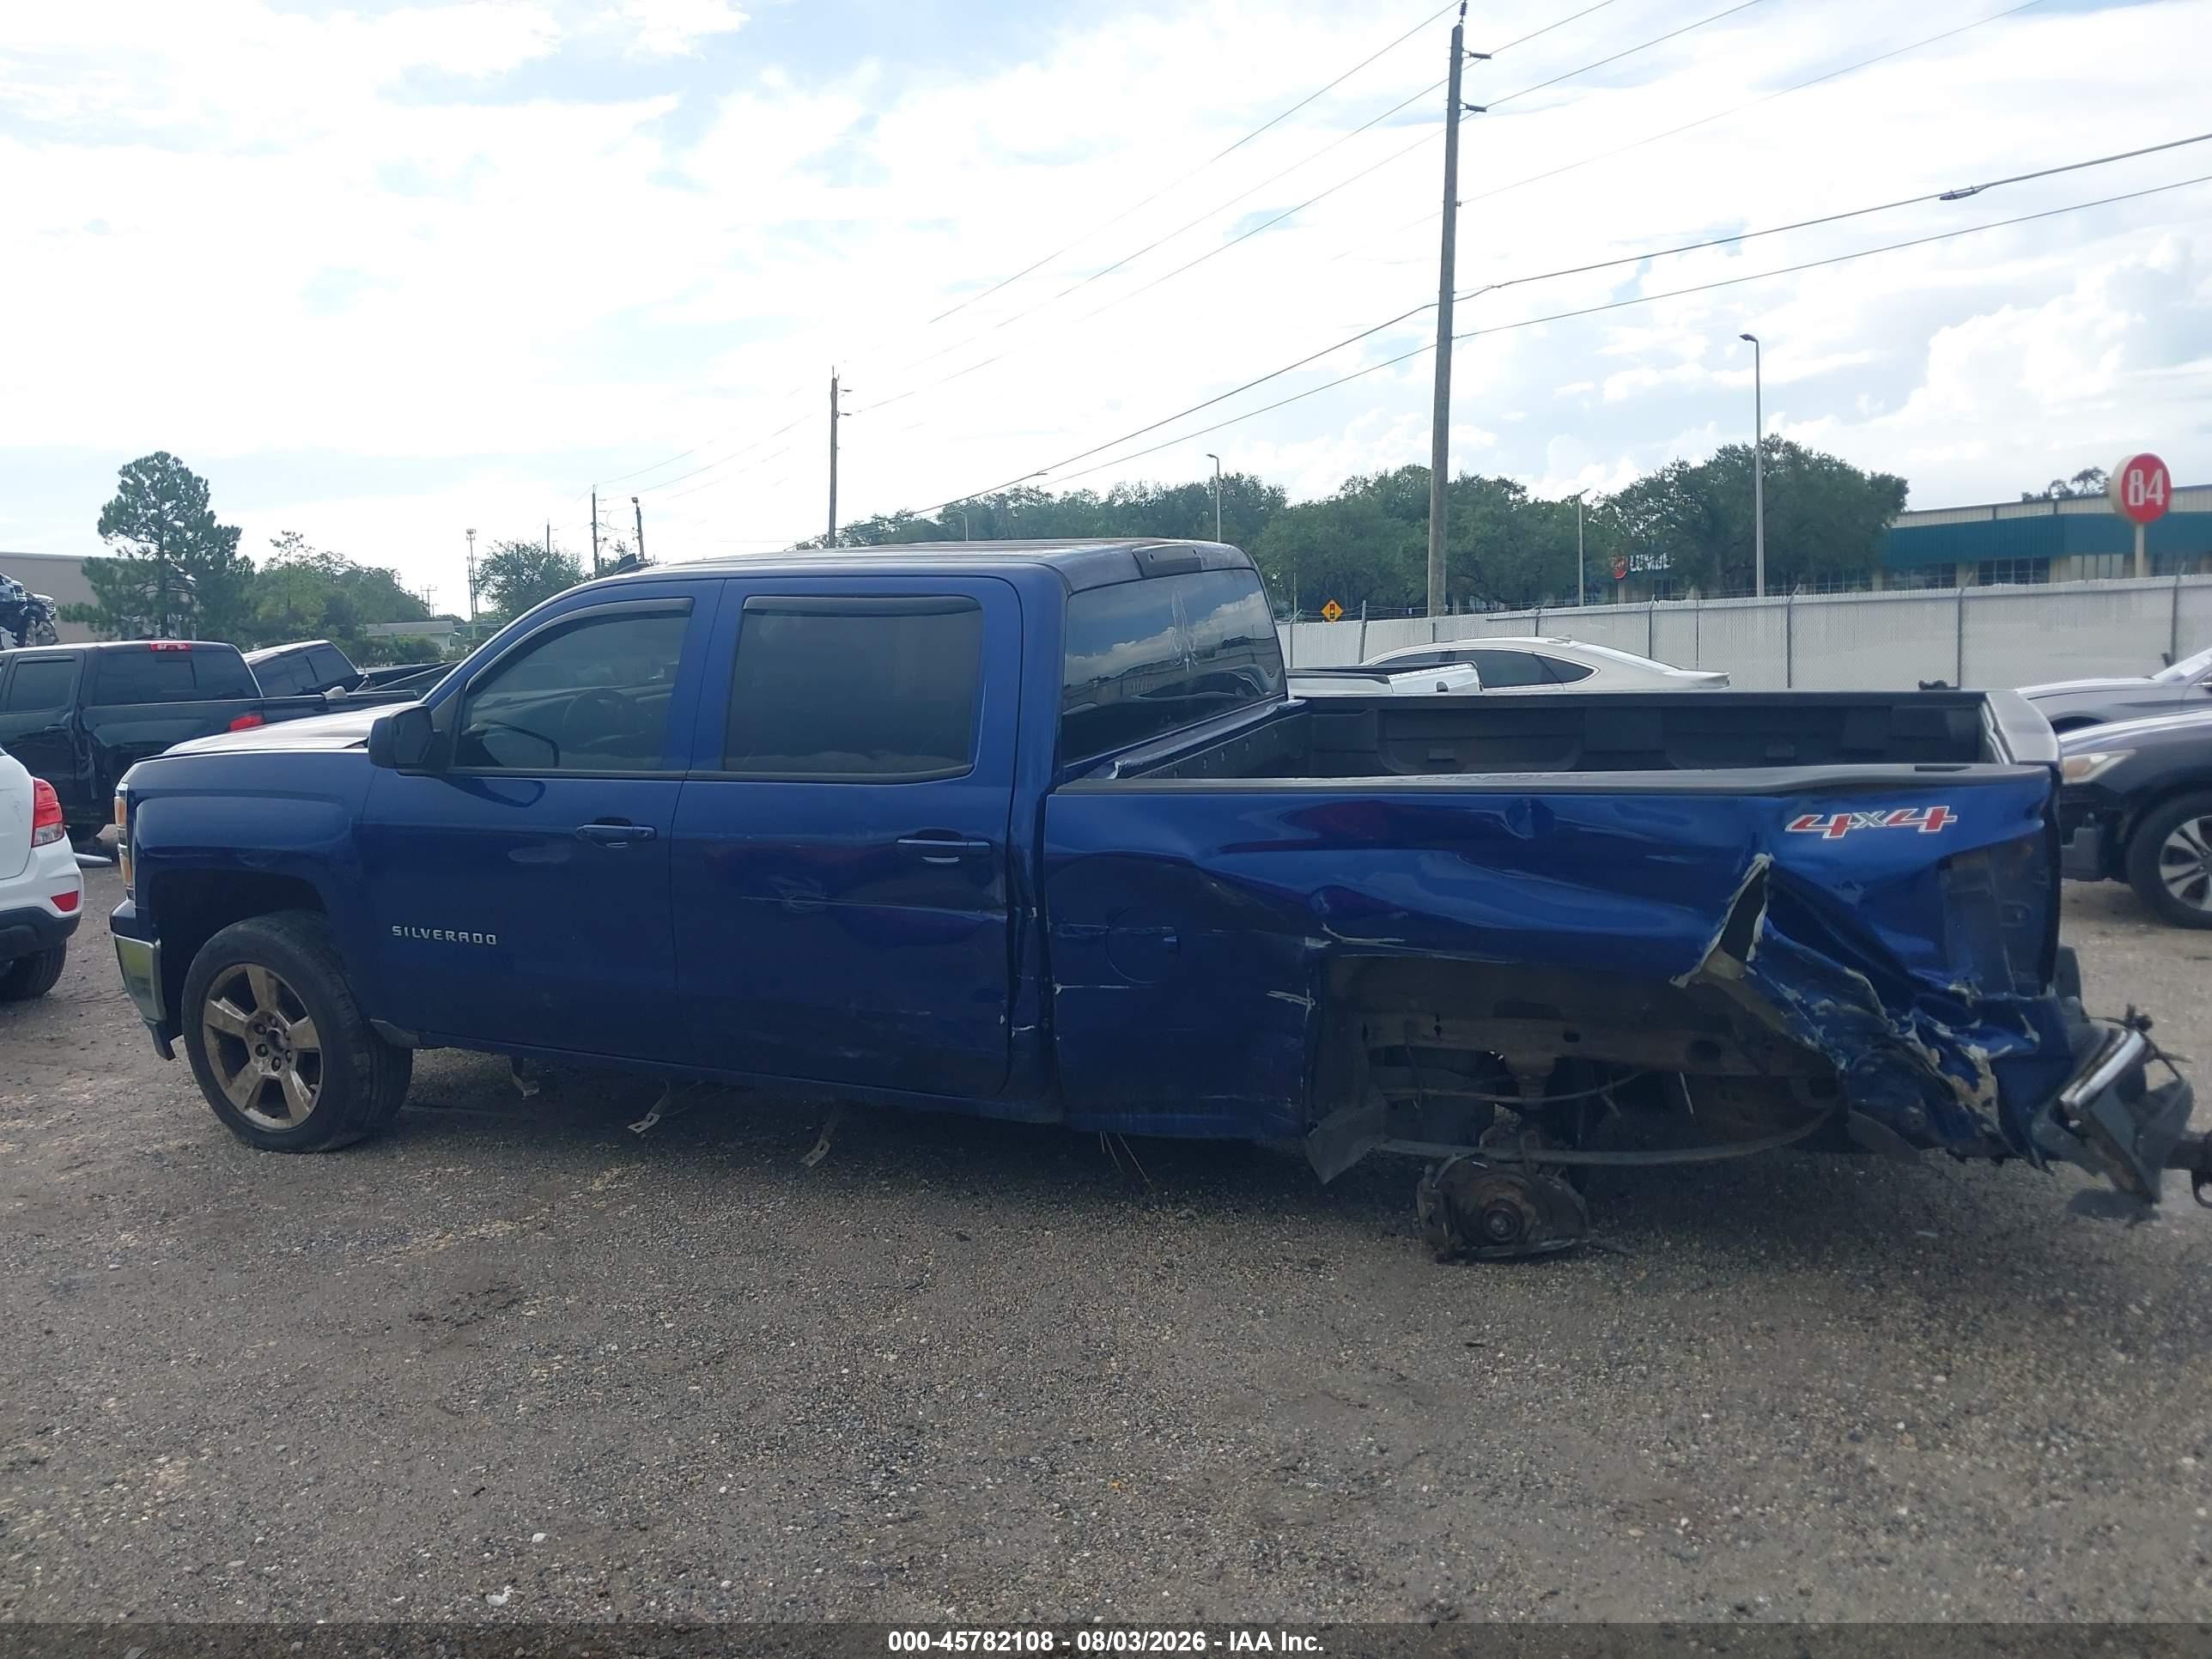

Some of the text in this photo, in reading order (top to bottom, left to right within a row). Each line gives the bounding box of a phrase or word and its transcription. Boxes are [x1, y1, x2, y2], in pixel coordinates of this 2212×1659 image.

[2128, 468, 2165, 507] 84
[1629, 552, 1674, 573] LUE
[392, 925, 497, 945] SILVERADO
